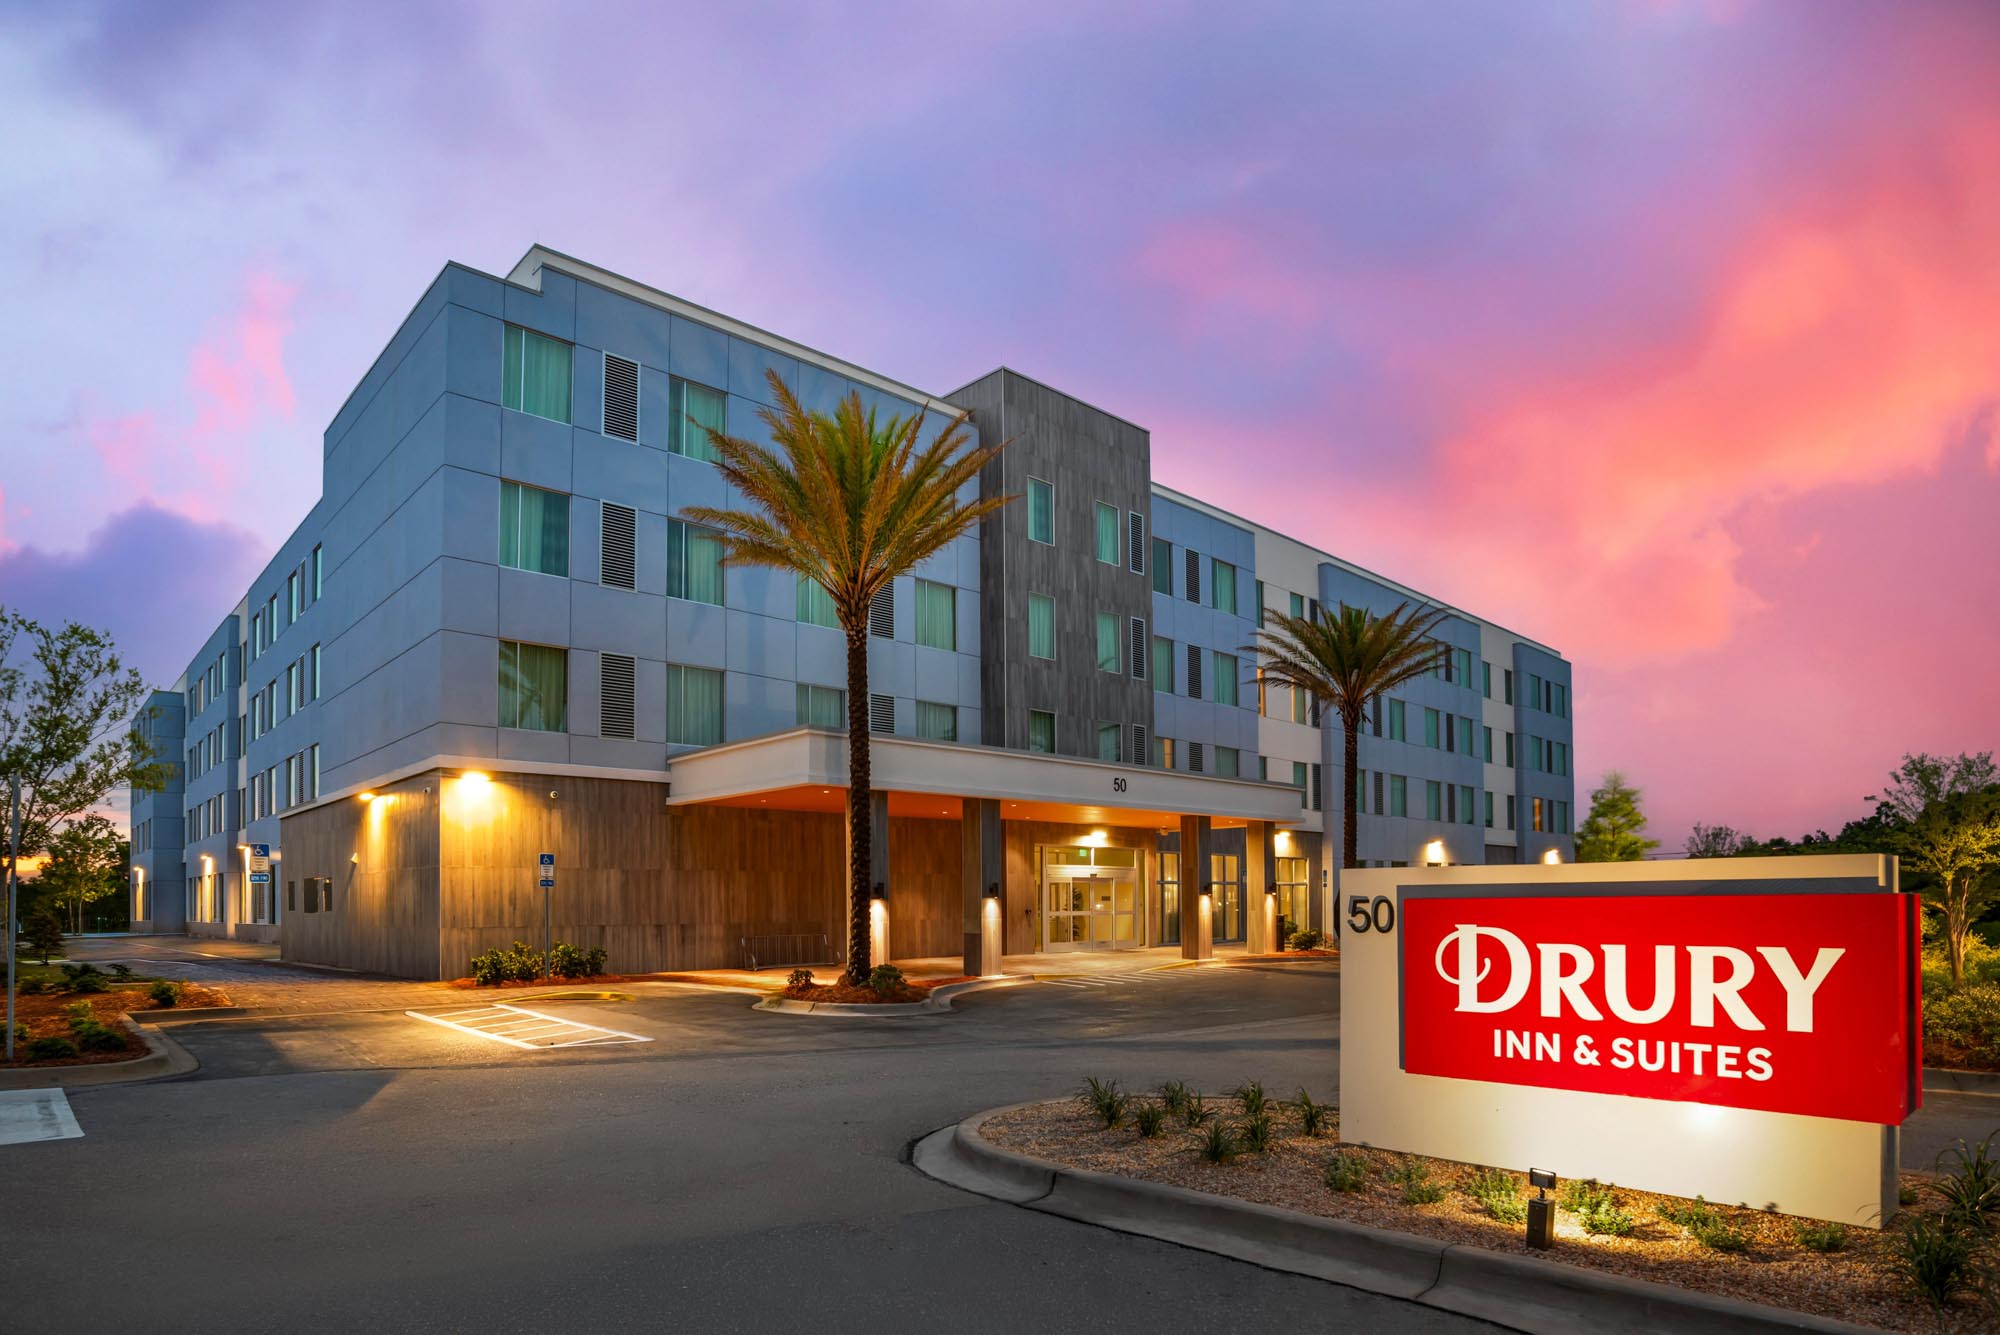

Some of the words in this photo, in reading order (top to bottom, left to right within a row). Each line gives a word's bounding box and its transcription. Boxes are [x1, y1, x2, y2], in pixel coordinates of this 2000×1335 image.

[1114, 777, 1127, 792] 50
[1347, 895, 1395, 934] 50
[1435, 924, 1846, 1033] DRURY
[1493, 1029, 1561, 1063] INN
[1573, 1034, 1601, 1067] &
[1610, 1037, 1774, 1081] SUITES
